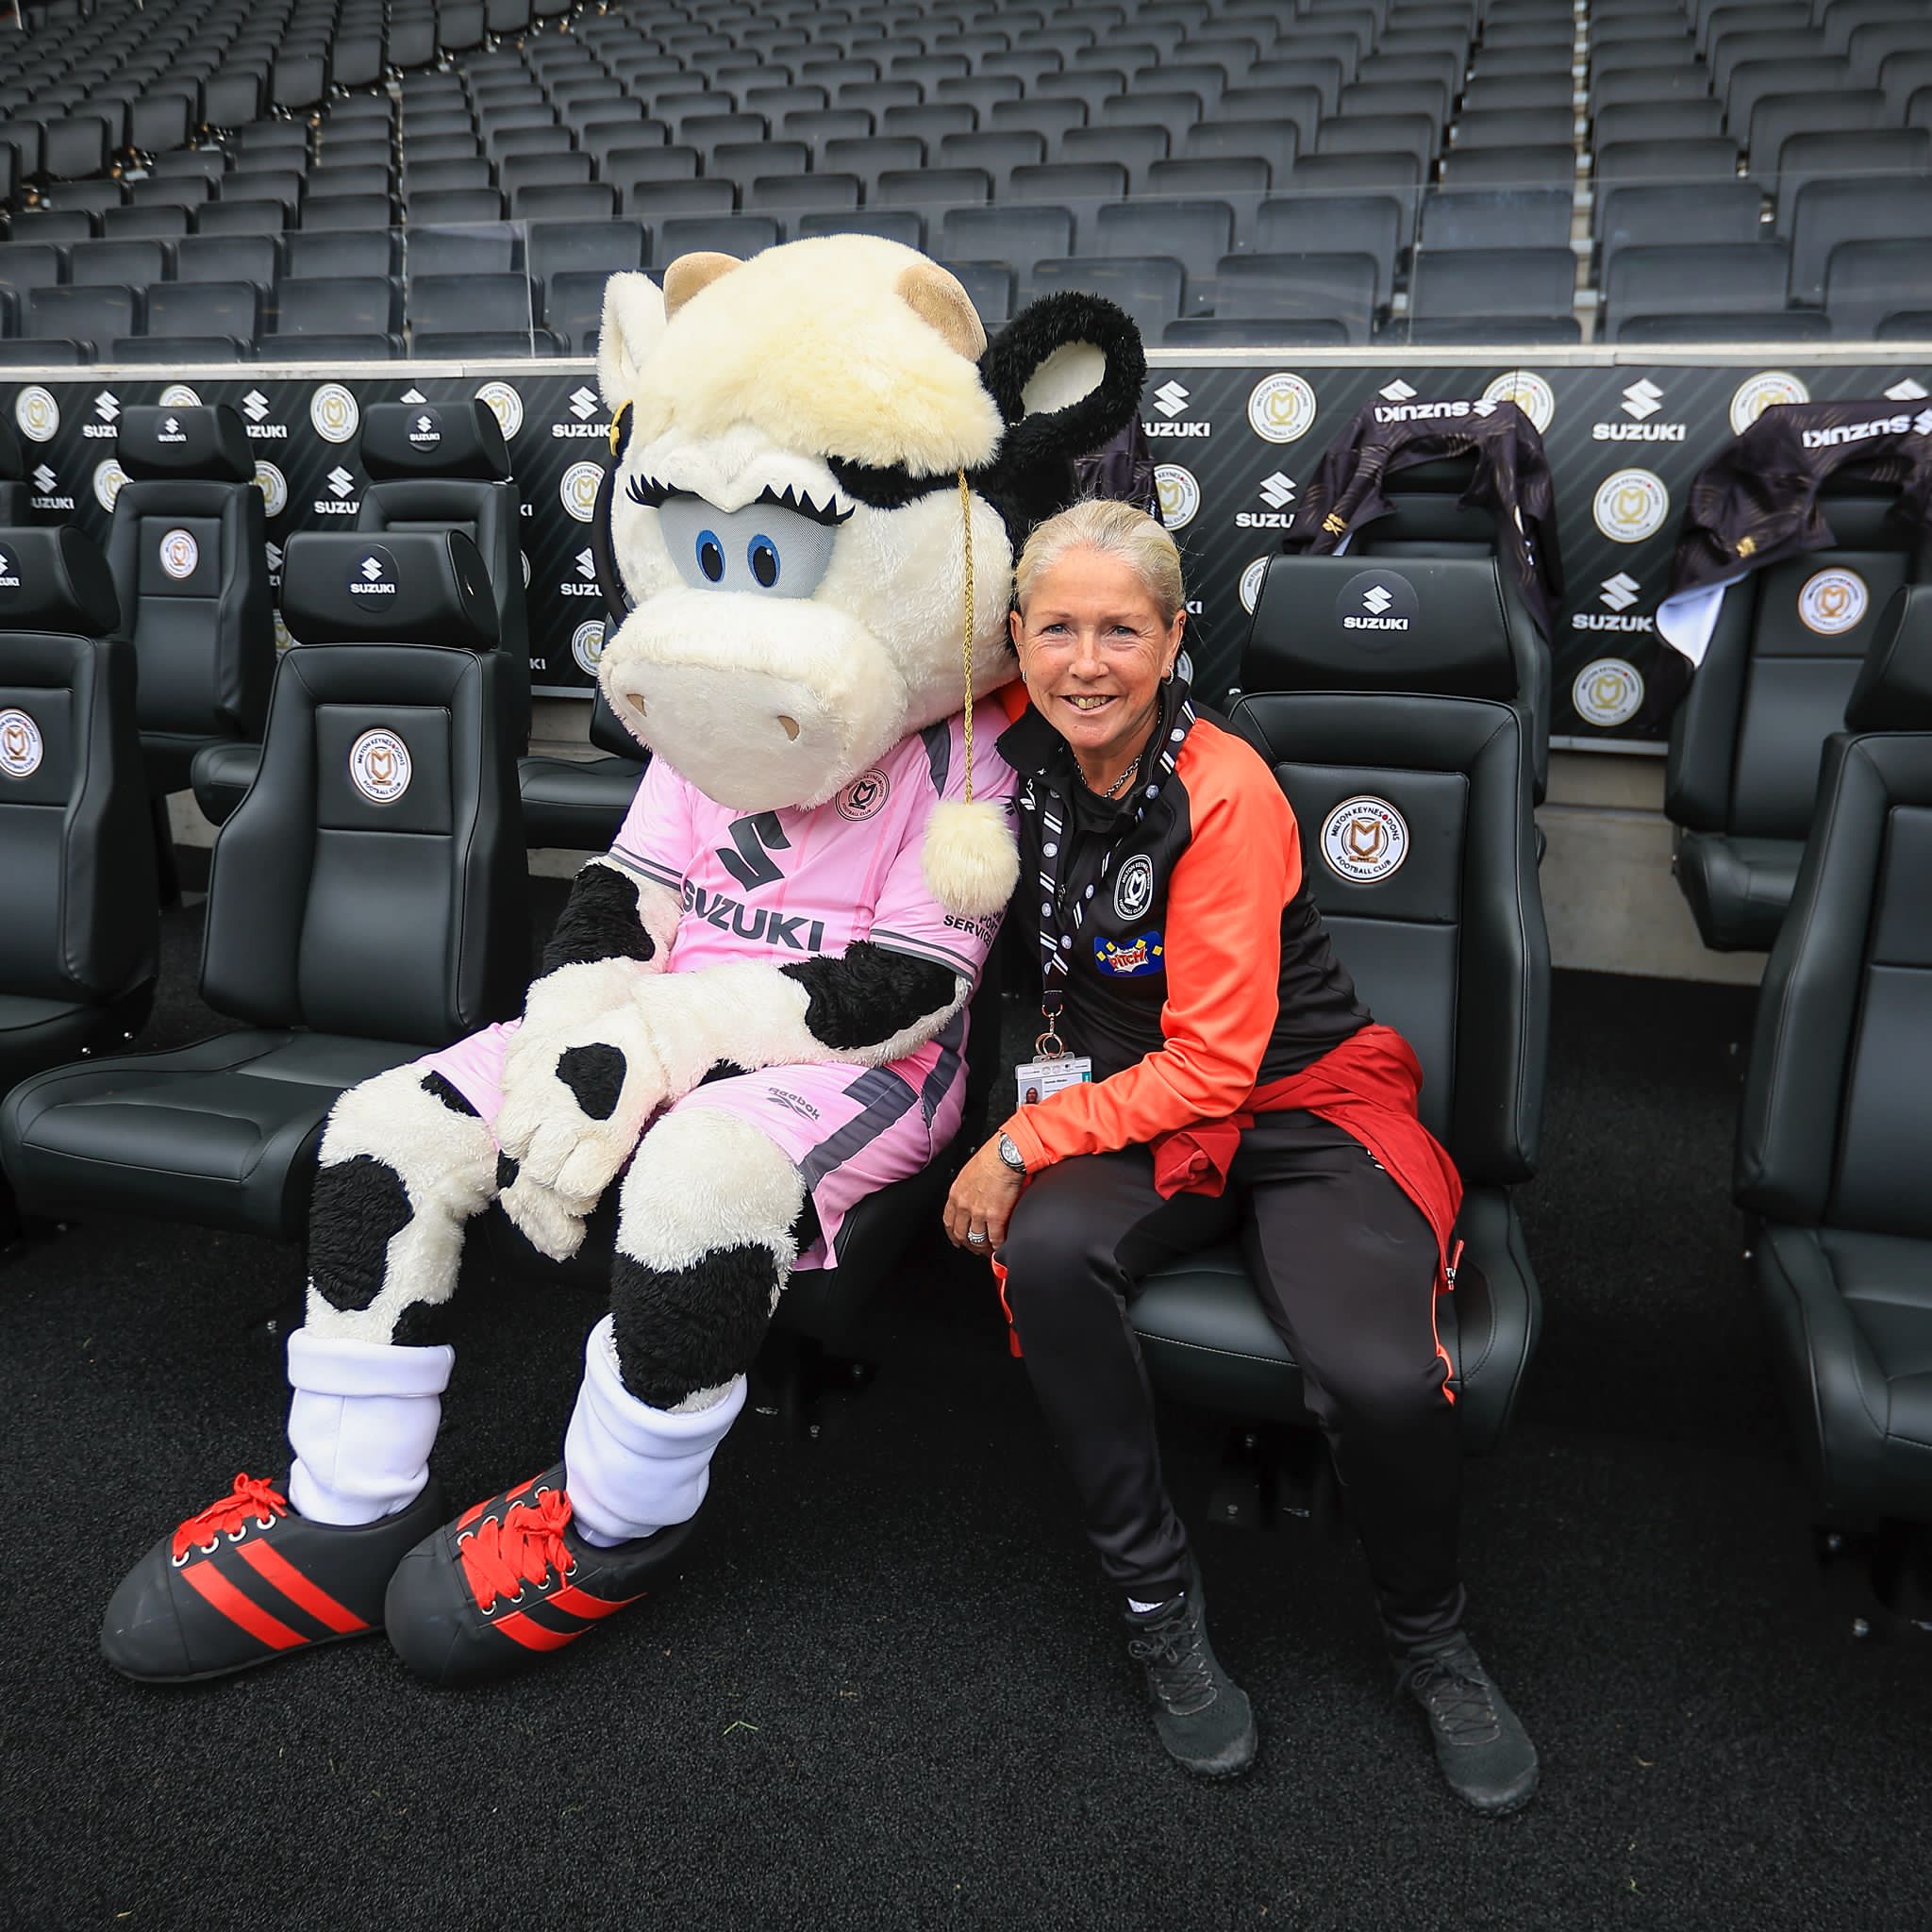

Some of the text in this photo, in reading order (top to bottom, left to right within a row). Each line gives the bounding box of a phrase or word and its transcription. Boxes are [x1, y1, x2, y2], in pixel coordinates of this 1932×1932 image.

[1374, 401, 1470, 423] SUZUKI
[82, 425, 118, 438] SUZ
[246, 425, 287, 439] ZUKI
[409, 432, 441, 441] SUZUKI
[552, 423, 611, 438] SUZUK
[1141, 422, 1210, 437] UZUKI
[1591, 423, 1687, 441] SUZUKI
[1802, 414, 1911, 448] SUZUKI
[158, 433, 188, 442] SUZUKI
[31, 497, 75, 509] UZUKI
[314, 501, 359, 514] SUZU
[1235, 512, 1295, 528] SUZU
[350, 583, 395, 593] SUZUKI
[560, 583, 603, 597] SUZ
[1343, 616, 1408, 630] SUZUKI
[1572, 613, 1653, 632] SUZUK
[1331, 807, 1400, 841] MILTON KEYNES DONS
[1336, 856, 1391, 875] FOOTBALL CLUB
[683, 878, 824, 952] SUZUKI
[1108, 946, 1145, 969] PITCH
